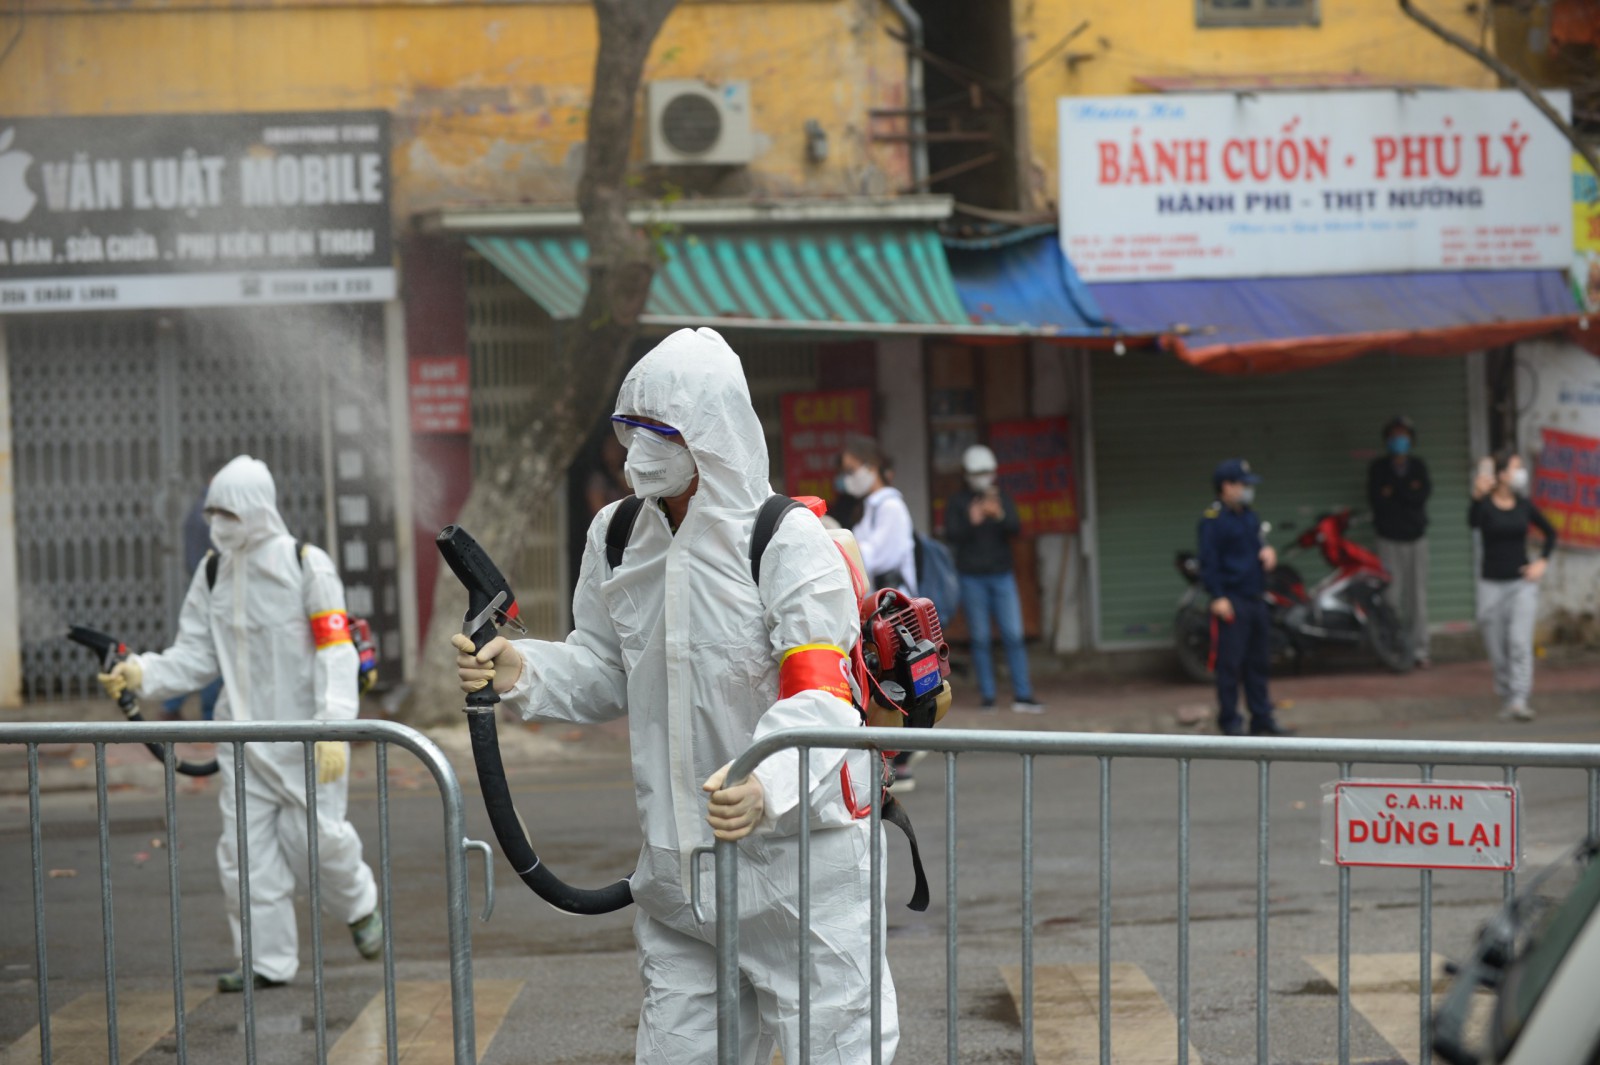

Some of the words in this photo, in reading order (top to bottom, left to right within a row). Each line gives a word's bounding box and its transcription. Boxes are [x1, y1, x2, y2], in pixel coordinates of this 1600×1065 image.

[1097, 127, 1208, 185] BÁNH
[1221, 116, 1329, 183] CUỐN
[1373, 116, 1462, 179] PHỦ
[1478, 119, 1530, 177] LÝ
[131, 148, 225, 217] LUẬT
[240, 153, 383, 208] MOBILE
[1385, 793, 1463, 810] C.A.H.N
[1348, 811, 1439, 845] DỪNG
[1448, 823, 1501, 853] LẠI
